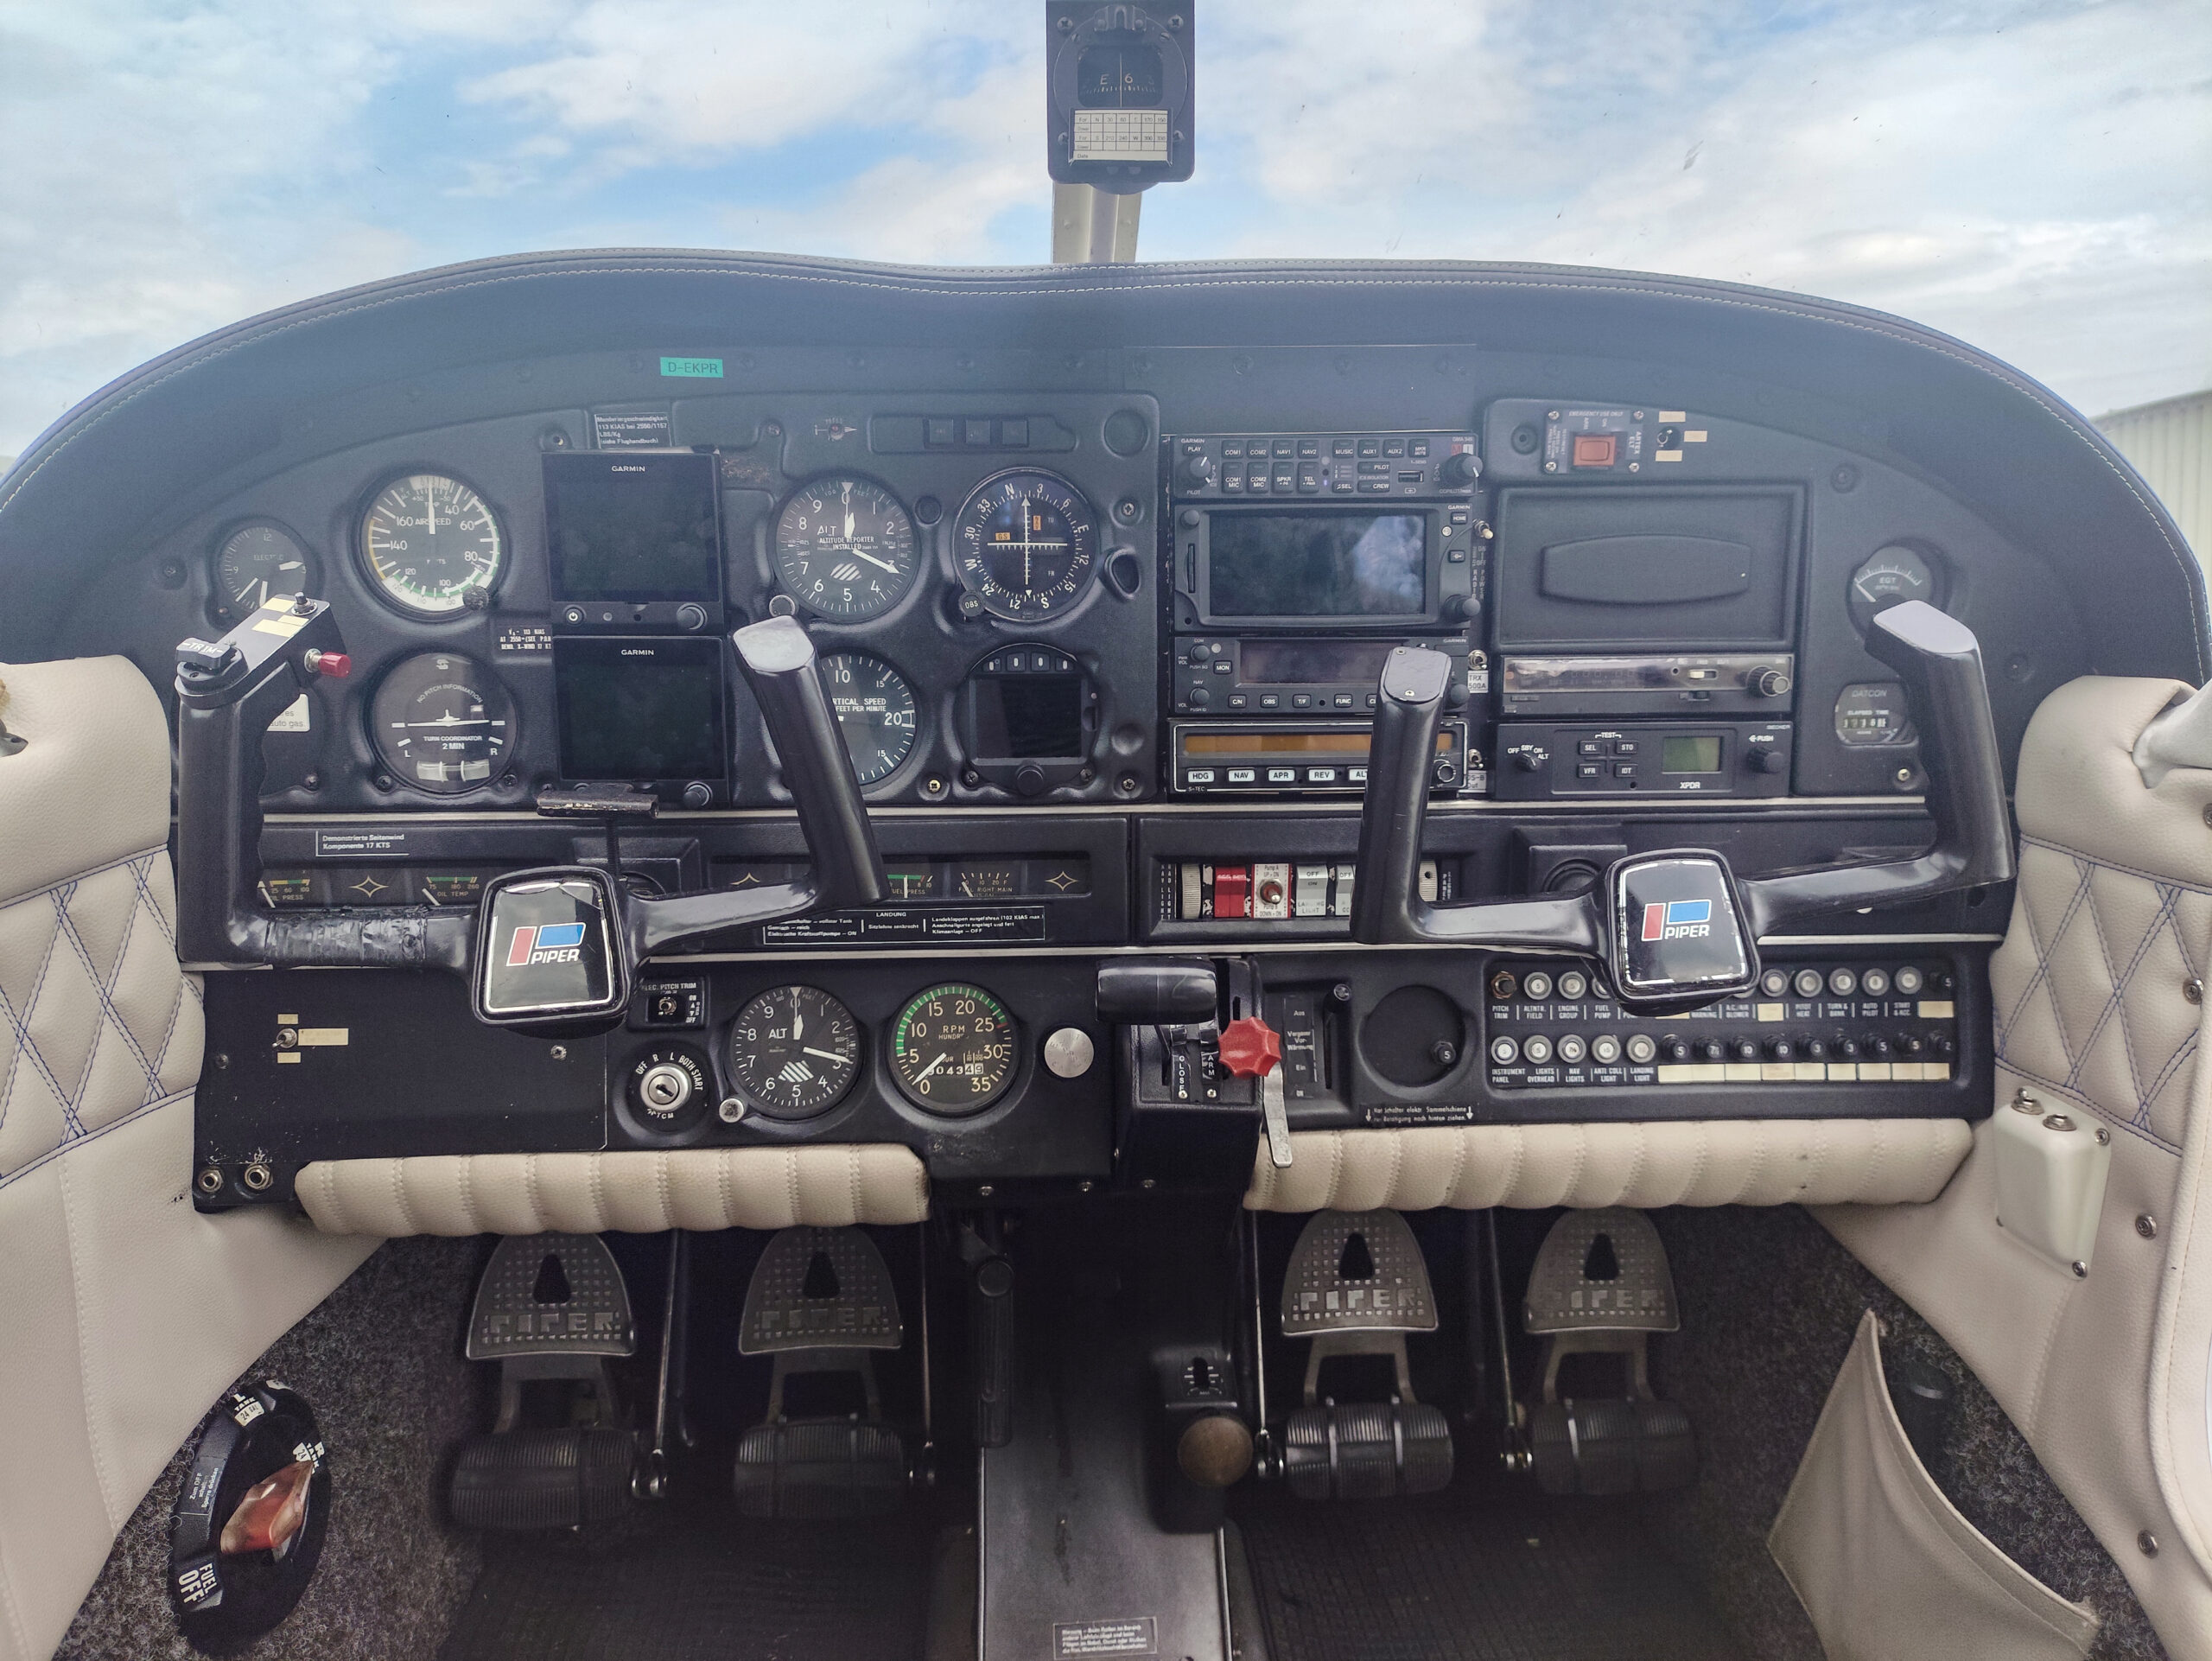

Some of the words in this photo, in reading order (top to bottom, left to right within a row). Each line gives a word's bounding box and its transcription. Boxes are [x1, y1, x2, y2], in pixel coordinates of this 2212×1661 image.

[1100, 73, 1109, 85] E
[1124, 73, 1134, 84] 6
[668, 361, 718, 373] D-EKPR
[445, 505, 460, 515] 40
[976, 498, 991, 512] 33
[396, 516, 414, 527] 160
[460, 520, 475, 531] 60
[817, 525, 836, 537] ALT
[964, 525, 976, 539] 30
[390, 540, 408, 550] 140
[464, 550, 478, 562] 80
[1078, 554, 1090, 565] 12
[964, 600, 979, 608] OBS
[835, 670, 850, 683] 10
[416, 694, 426, 703] NO
[424, 684, 442, 697] PITCH
[442, 684, 483, 703] INFORMATION
[1852, 690, 1887, 698] DATCON
[884, 711, 902, 726] 20
[1664, 924, 1710, 939] PIPER
[530, 949, 580, 964] PIPER
[928, 1002, 944, 1017] 15
[955, 999, 976, 1015] 20
[911, 1022, 926, 1038] 10
[975, 1017, 995, 1032] 25
[768, 1028, 788, 1039] ALT
[909, 1048, 919, 1063] 5
[983, 1044, 1003, 1060] 30
[635, 1060, 648, 1075] OFF
[678, 1055, 696, 1071] BOTH
[691, 1069, 703, 1091] START
[919, 1079, 931, 1094] 0
[971, 1077, 991, 1092] 35
[233, 1392, 245, 1403] L
[234, 1397, 256, 1412] TANK
[240, 1410, 250, 1422] 24
[249, 1404, 258, 1414] GAL
[297, 1448, 306, 1461] 24
[314, 1441, 326, 1458] R
[189, 1486, 198, 1500] Zum
[194, 1472, 203, 1486] OFF
[199, 1562, 218, 1595] FUEL
[178, 1569, 202, 1604] OFF
